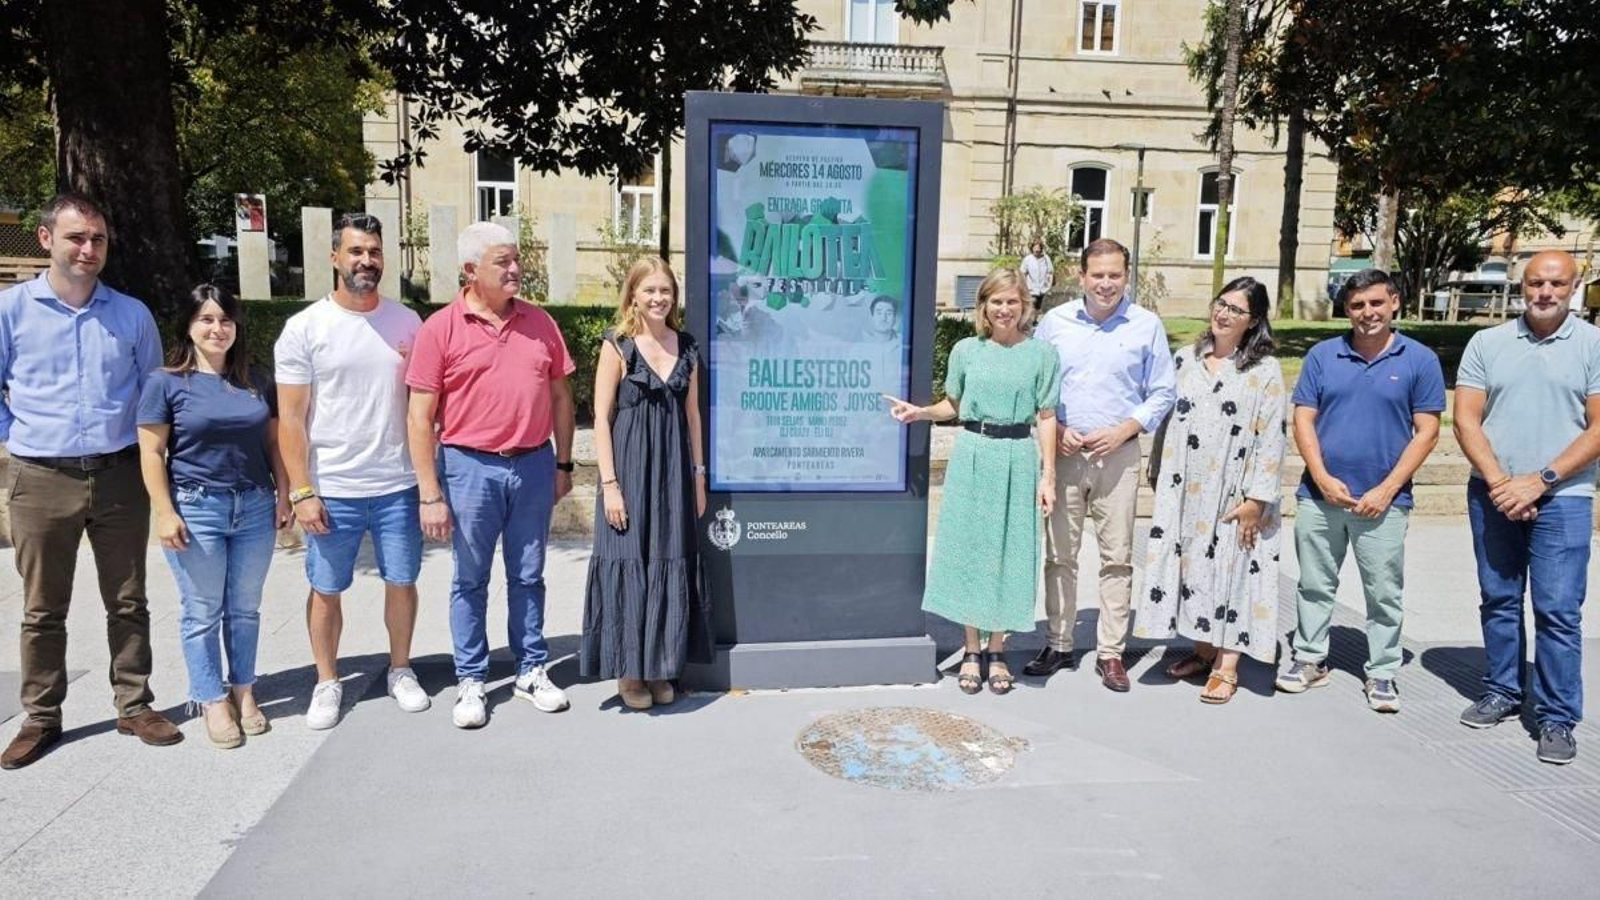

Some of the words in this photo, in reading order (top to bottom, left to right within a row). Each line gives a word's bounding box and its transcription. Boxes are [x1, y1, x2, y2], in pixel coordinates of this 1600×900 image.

[760, 160, 810, 179] MÉRCORES
[811, 163, 825, 180] 14
[827, 164, 862, 180] AGOSTO
[768, 197, 808, 213] ENTRADA
[748, 358, 872, 388] BALLESTEROS
[740, 392, 788, 412] GROOVE
[791, 392, 838, 412] AMIGOS
[844, 392, 882, 412] JOYSE
[752, 446, 801, 458] APARCAMENTO
[802, 447, 841, 458] SARMIENTO
[841, 447, 864, 458] RIVERA
[746, 522, 806, 530] PONTEAREAS
[746, 530, 788, 540] Concello
